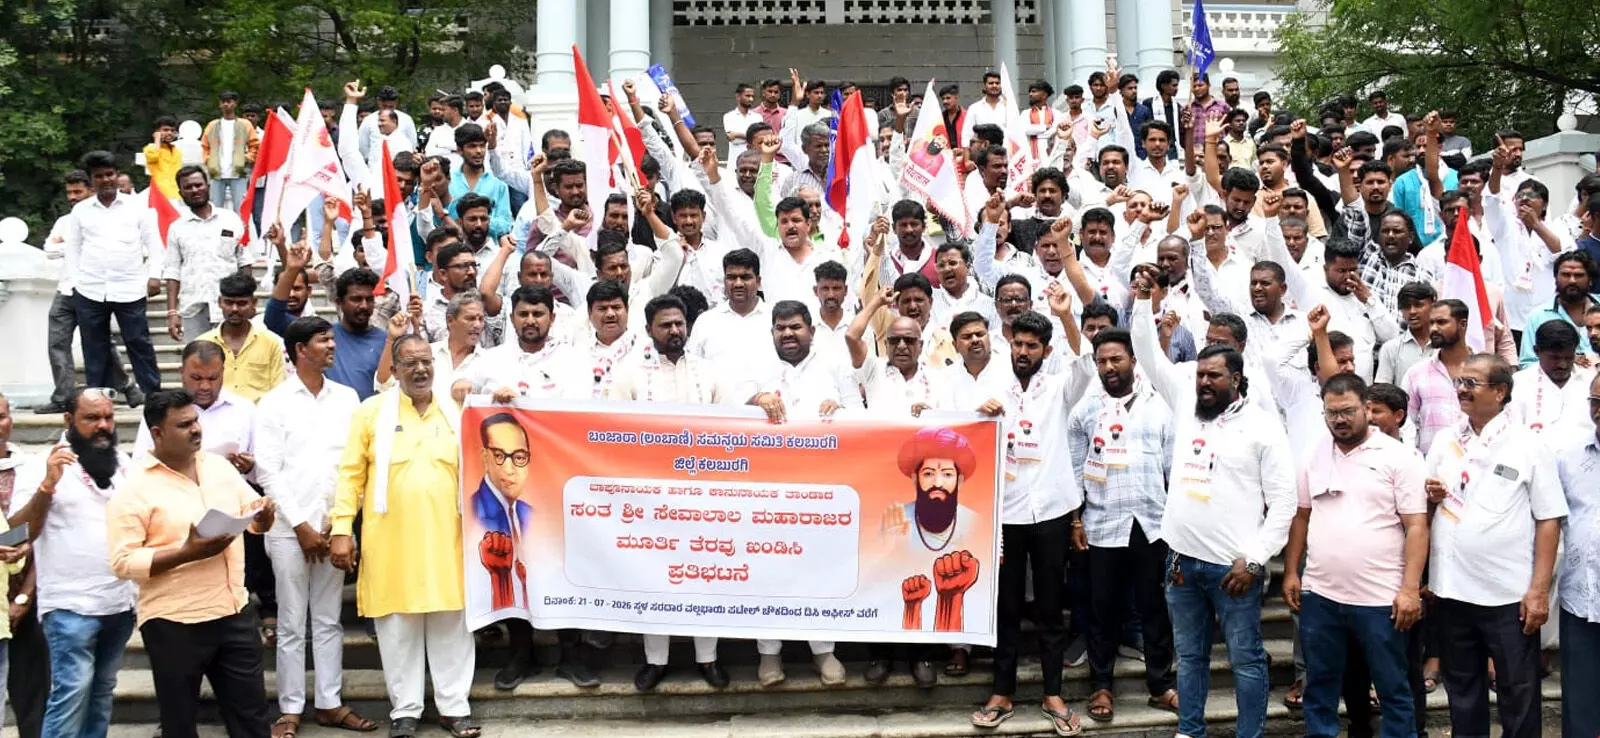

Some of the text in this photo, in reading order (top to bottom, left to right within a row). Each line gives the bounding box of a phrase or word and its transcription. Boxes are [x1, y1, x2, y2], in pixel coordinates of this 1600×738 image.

[589, 431, 636, 444] ಬಂಜಾರಾ
[696, 434, 747, 451] ಸಮನ್ವಯ
[751, 435, 783, 448] ಸಮಿತಿ
[786, 436, 837, 449] ಕಲಬುರಗಿ
[674, 456, 748, 474] ಜಿಲ್ಲೆ ಕಲಬುರಗಿ
[668, 485, 703, 496] ಹಾಗೂ
[570, 502, 852, 526] ಸಂತ ಶ್ರೀ ಸೇವಾಲಾಲ ಮಹಾರಾಜರ
[616, 534, 803, 557] ಮೂರ್ತಿ ತೆರವು ಖಂಡಿಸಿ
[668, 562, 749, 584] ಪ್ರತಿಭಟನೆ
[543, 596, 576, 606] ದಿನಾಂಕ:
[578, 597, 587, 605] 21
[594, 598, 604, 607] 07
[612, 600, 632, 610] 2026
[650, 602, 682, 613] ಸರದಾರ
[728, 604, 760, 615] ಪಟೇಲ್
[804, 606, 819, 617] ಡಿಸಿ
[821, 607, 854, 619] ಆಫೀಸ್
[856, 608, 878, 618] ವರೆಗೆ
